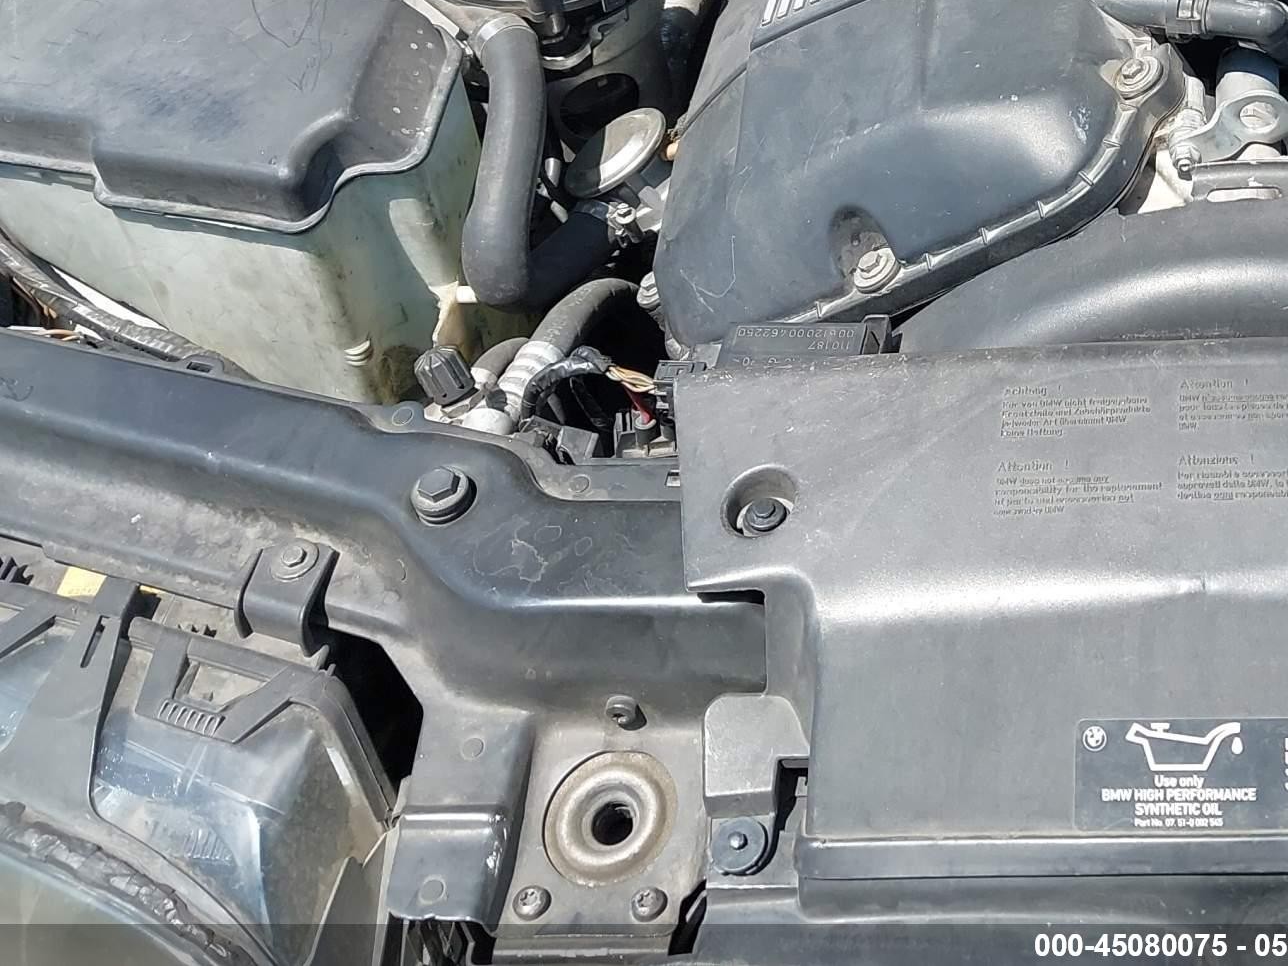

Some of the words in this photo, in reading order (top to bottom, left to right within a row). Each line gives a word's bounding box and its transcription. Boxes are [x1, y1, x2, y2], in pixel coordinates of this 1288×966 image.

[1154, 775, 1178, 788] Use
[1179, 775, 1205, 789] only
[1101, 788, 1133, 801] BMW
[1134, 788, 1164, 801] HIGH
[1167, 788, 1257, 801] PERFORMANCE
[1134, 803, 1201, 816] SYNTHETIC
[1202, 803, 1223, 816] OIL
